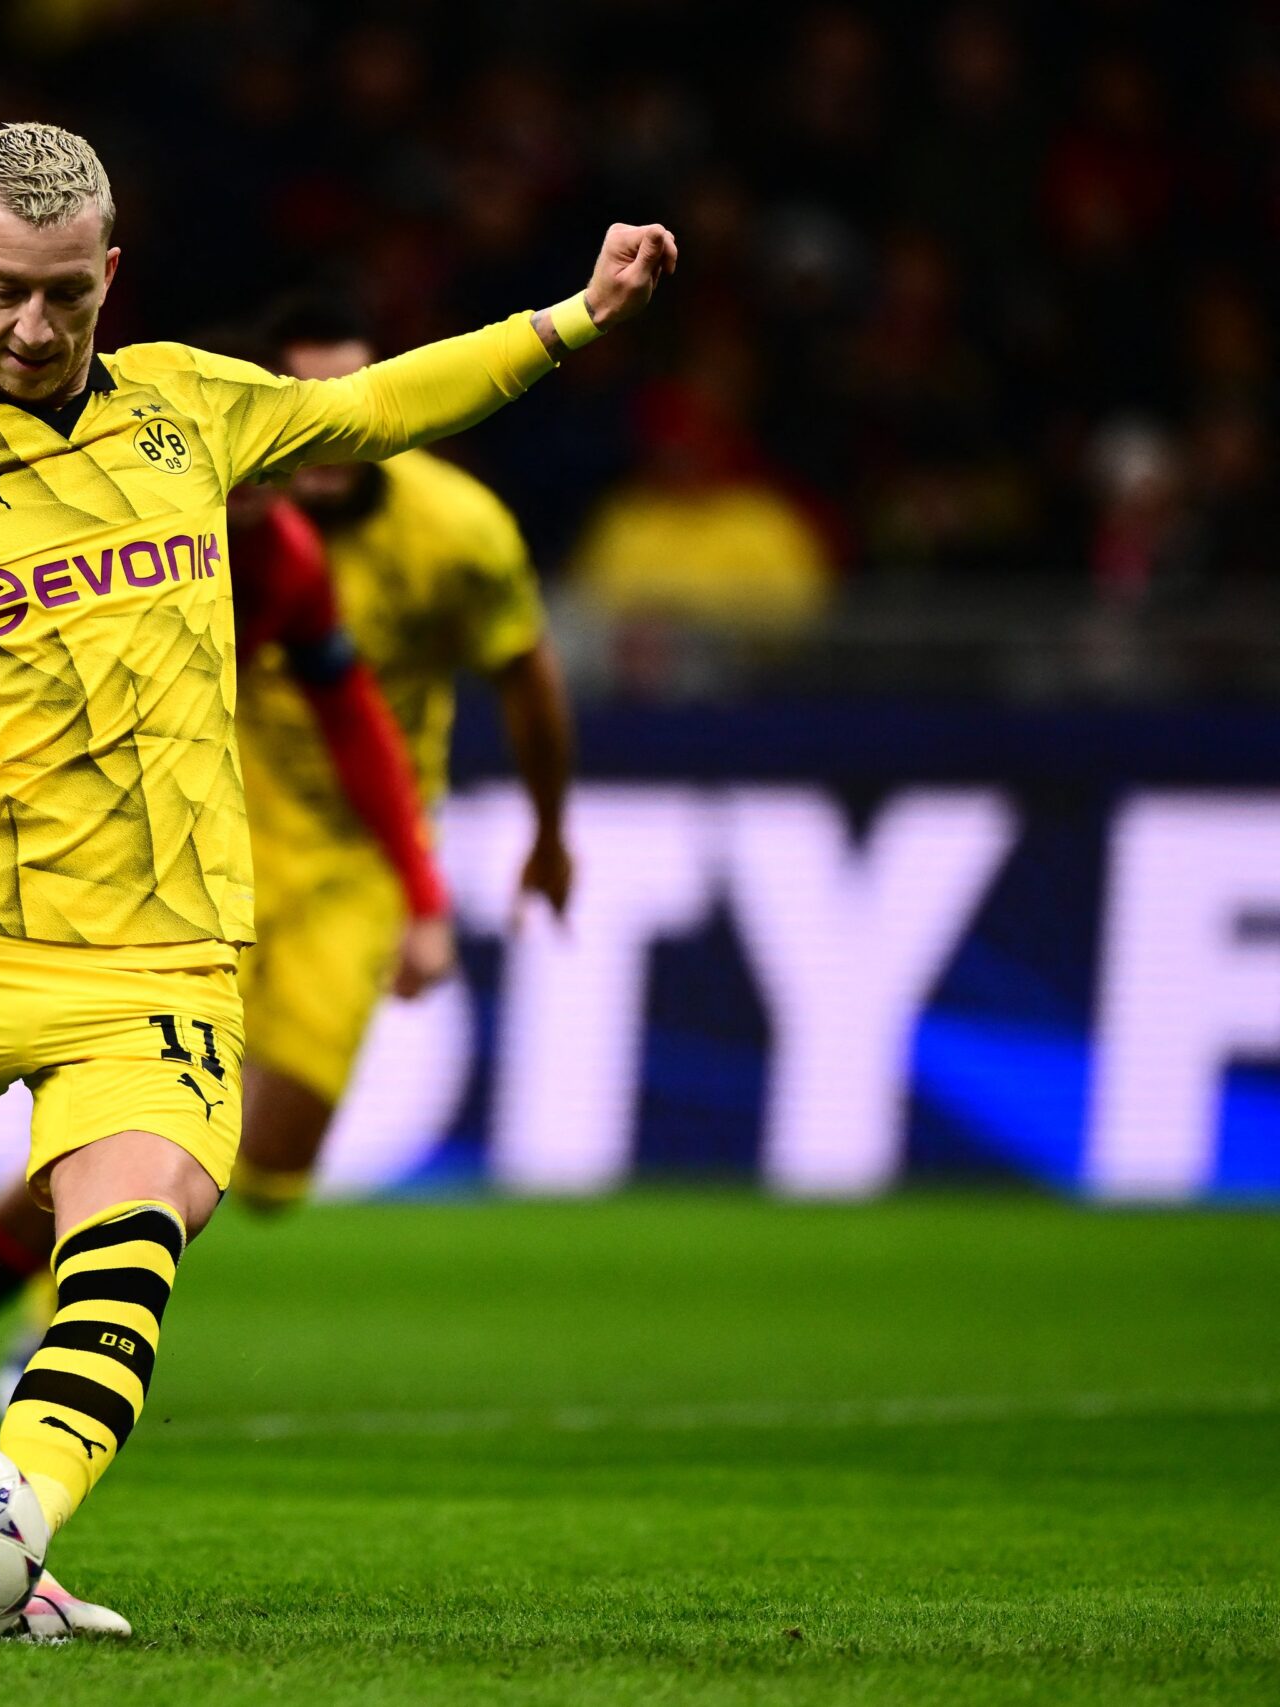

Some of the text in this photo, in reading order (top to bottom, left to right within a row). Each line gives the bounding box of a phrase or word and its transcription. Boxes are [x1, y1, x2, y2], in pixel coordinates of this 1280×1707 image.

[139, 424, 186, 461] BVB
[165, 457, 182, 469] 09
[33, 533, 221, 608] EVONIK
[149, 1015, 225, 1083] 11
[99, 1332, 136, 1356] 09
